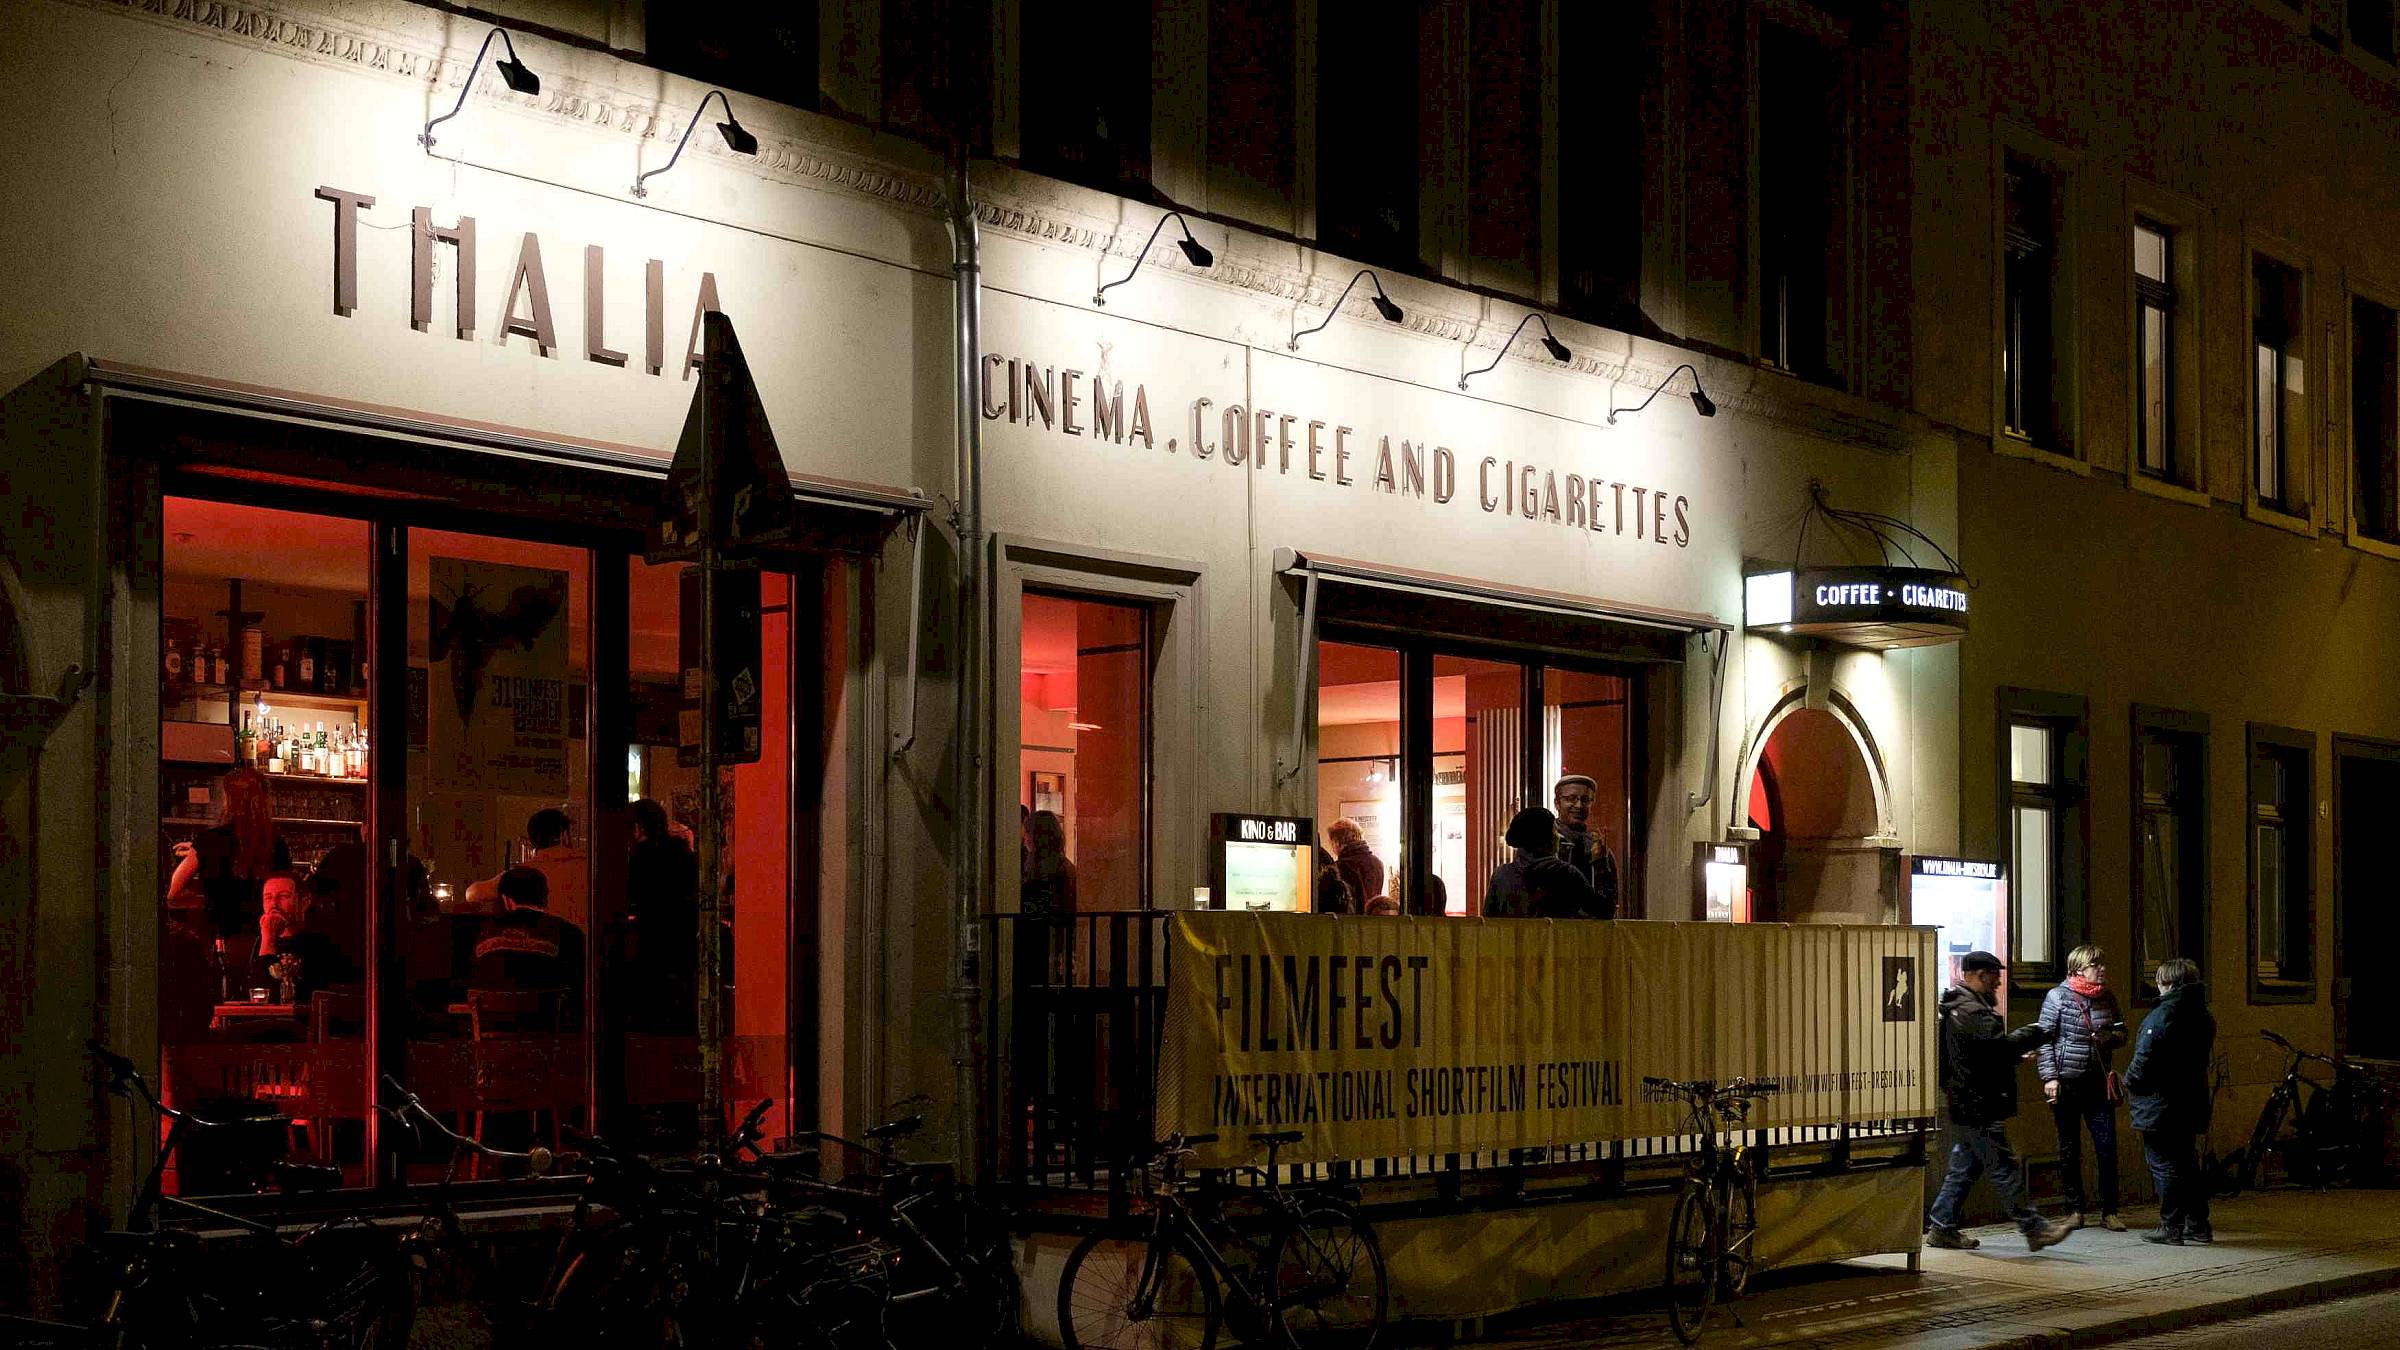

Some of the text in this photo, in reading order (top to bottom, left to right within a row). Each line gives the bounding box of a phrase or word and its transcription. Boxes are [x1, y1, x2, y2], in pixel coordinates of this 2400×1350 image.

[1190, 397, 1353, 486] COFFEE
[1374, 435, 1455, 503] AND
[1480, 456, 1690, 548] CIGARETTES
[1816, 585, 1967, 612] COFFEE CIGARETTES
[1241, 819, 1296, 841] KINO & BAR
[1214, 954, 1429, 1052] FILMFEST
[1213, 1059, 1623, 1127] INTERNATIONAL SHORTFILM FESTIVAL
